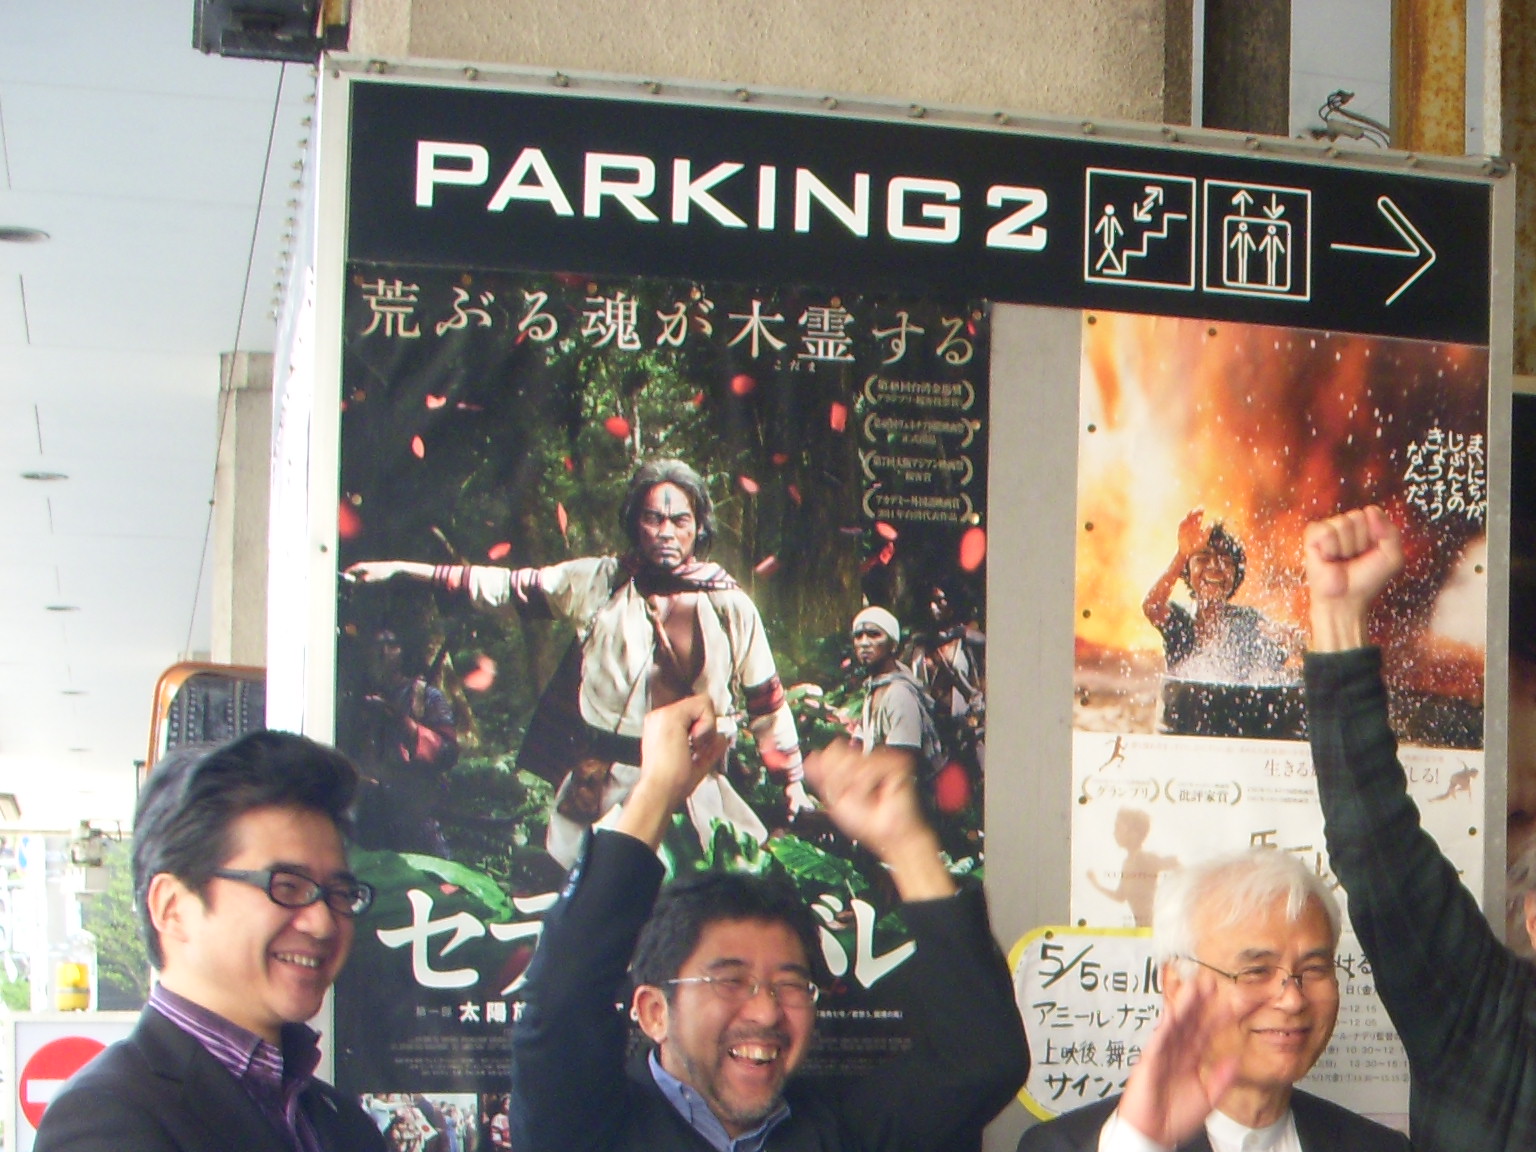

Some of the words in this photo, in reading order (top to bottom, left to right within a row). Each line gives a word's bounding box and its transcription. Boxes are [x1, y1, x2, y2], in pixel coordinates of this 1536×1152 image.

[361, 279, 974, 364] 荒ぶる魂が木霊する
[1446, 428, 1466, 514] じぶんとの
